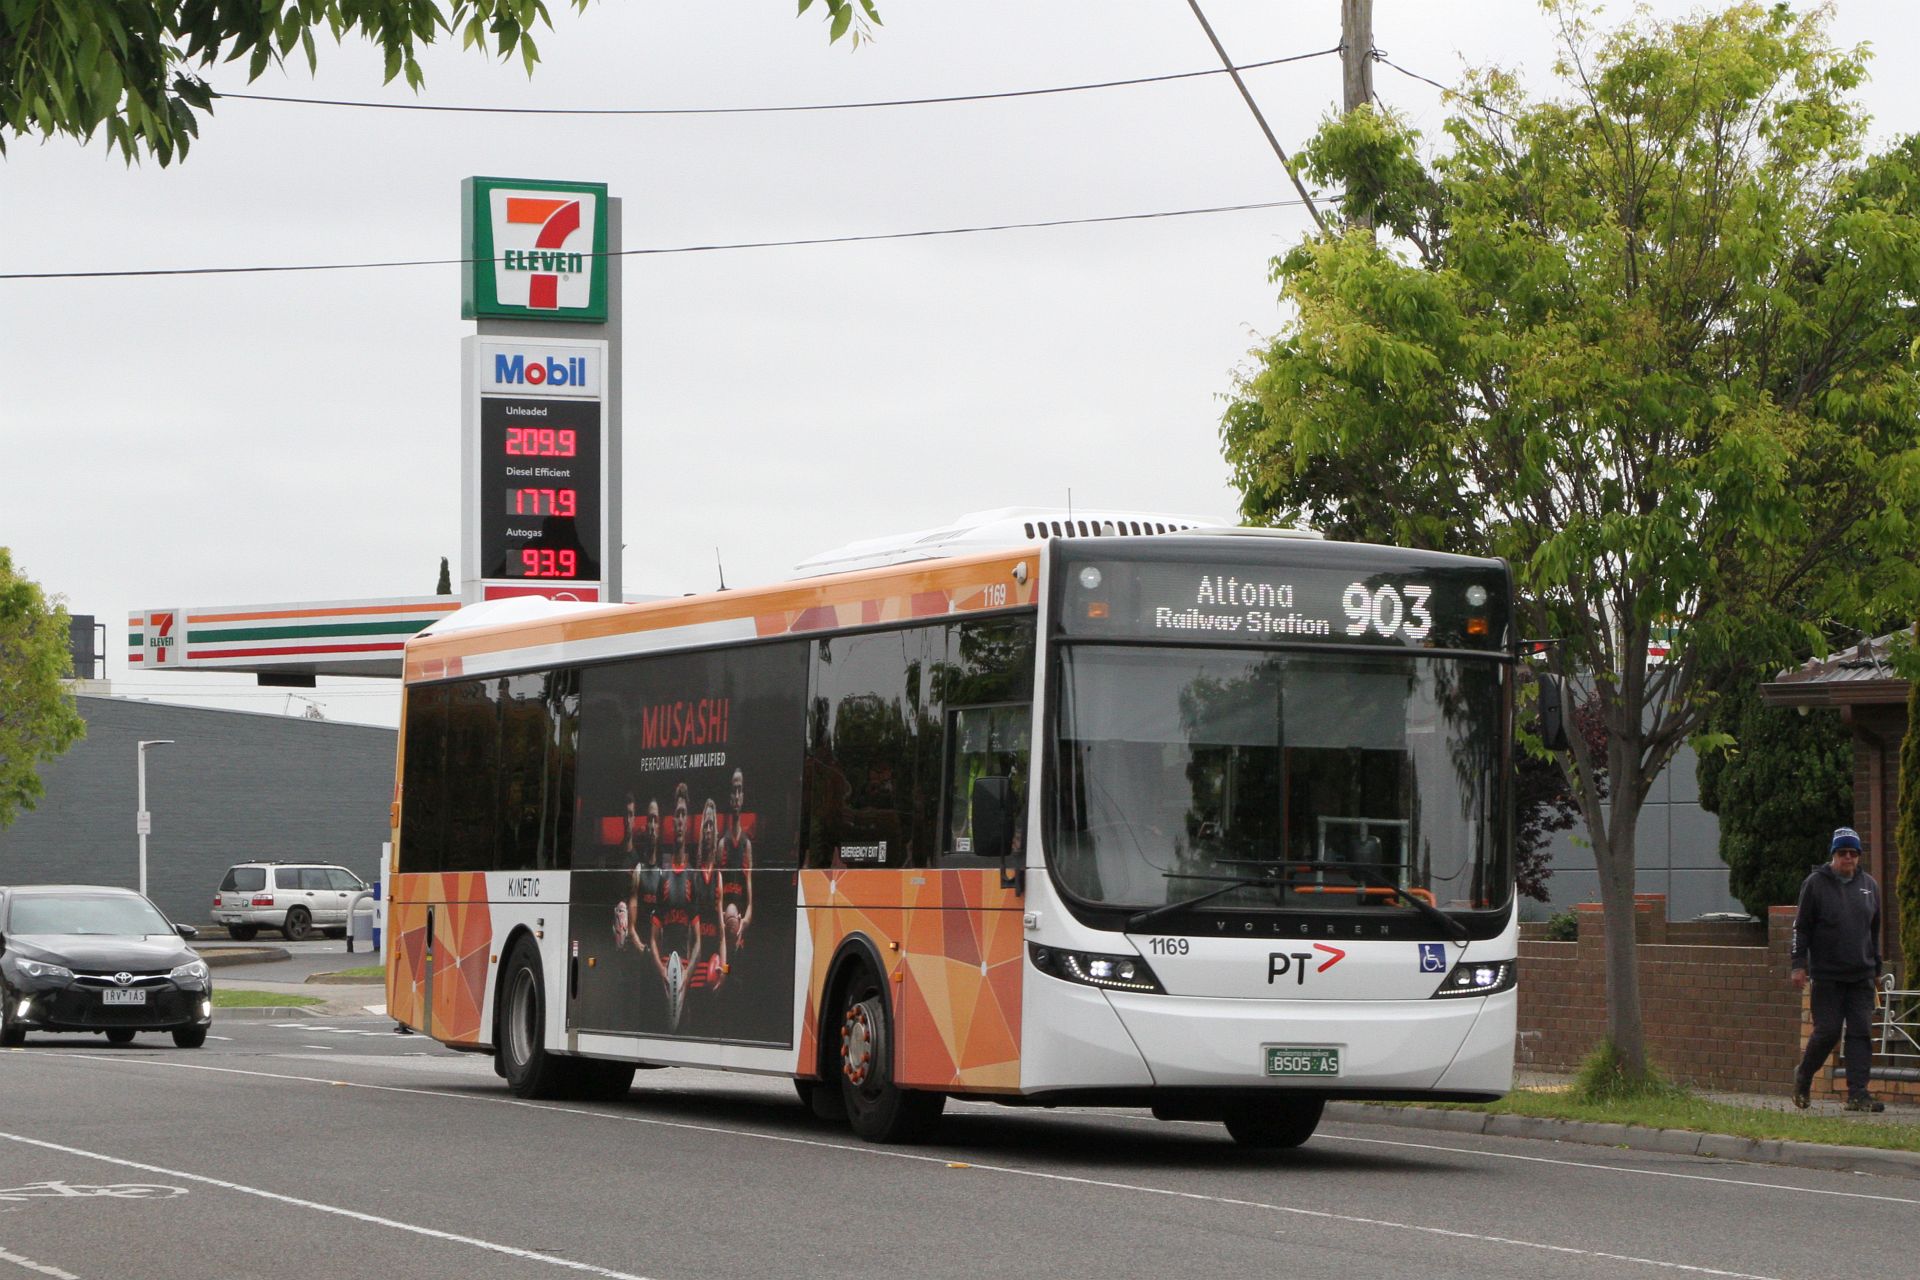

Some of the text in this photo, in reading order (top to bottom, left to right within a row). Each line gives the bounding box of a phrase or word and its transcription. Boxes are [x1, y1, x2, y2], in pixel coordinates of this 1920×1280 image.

[495, 353, 586, 387] Mobil
[505, 406, 548, 416] Unleaded
[506, 466, 571, 478] Diesel Efficient
[506, 527, 543, 539] Autogas
[983, 583, 1007, 607] 1169
[1197, 575, 1293, 608] Altona
[1342, 582, 1432, 639] 903
[1155, 607, 1330, 636] Railway Station
[641, 698, 729, 750] MUSASHI
[640, 752, 726, 772] PERFORMANCE AMPLIFIED
[840, 846, 879, 858] EMERGENCY EXIT
[1216, 921, 1389, 935] VOLGREN
[1148, 937, 1190, 956] 1169
[105, 991, 121, 1001] 1RV
[1320, 1057, 1338, 1071] AS
